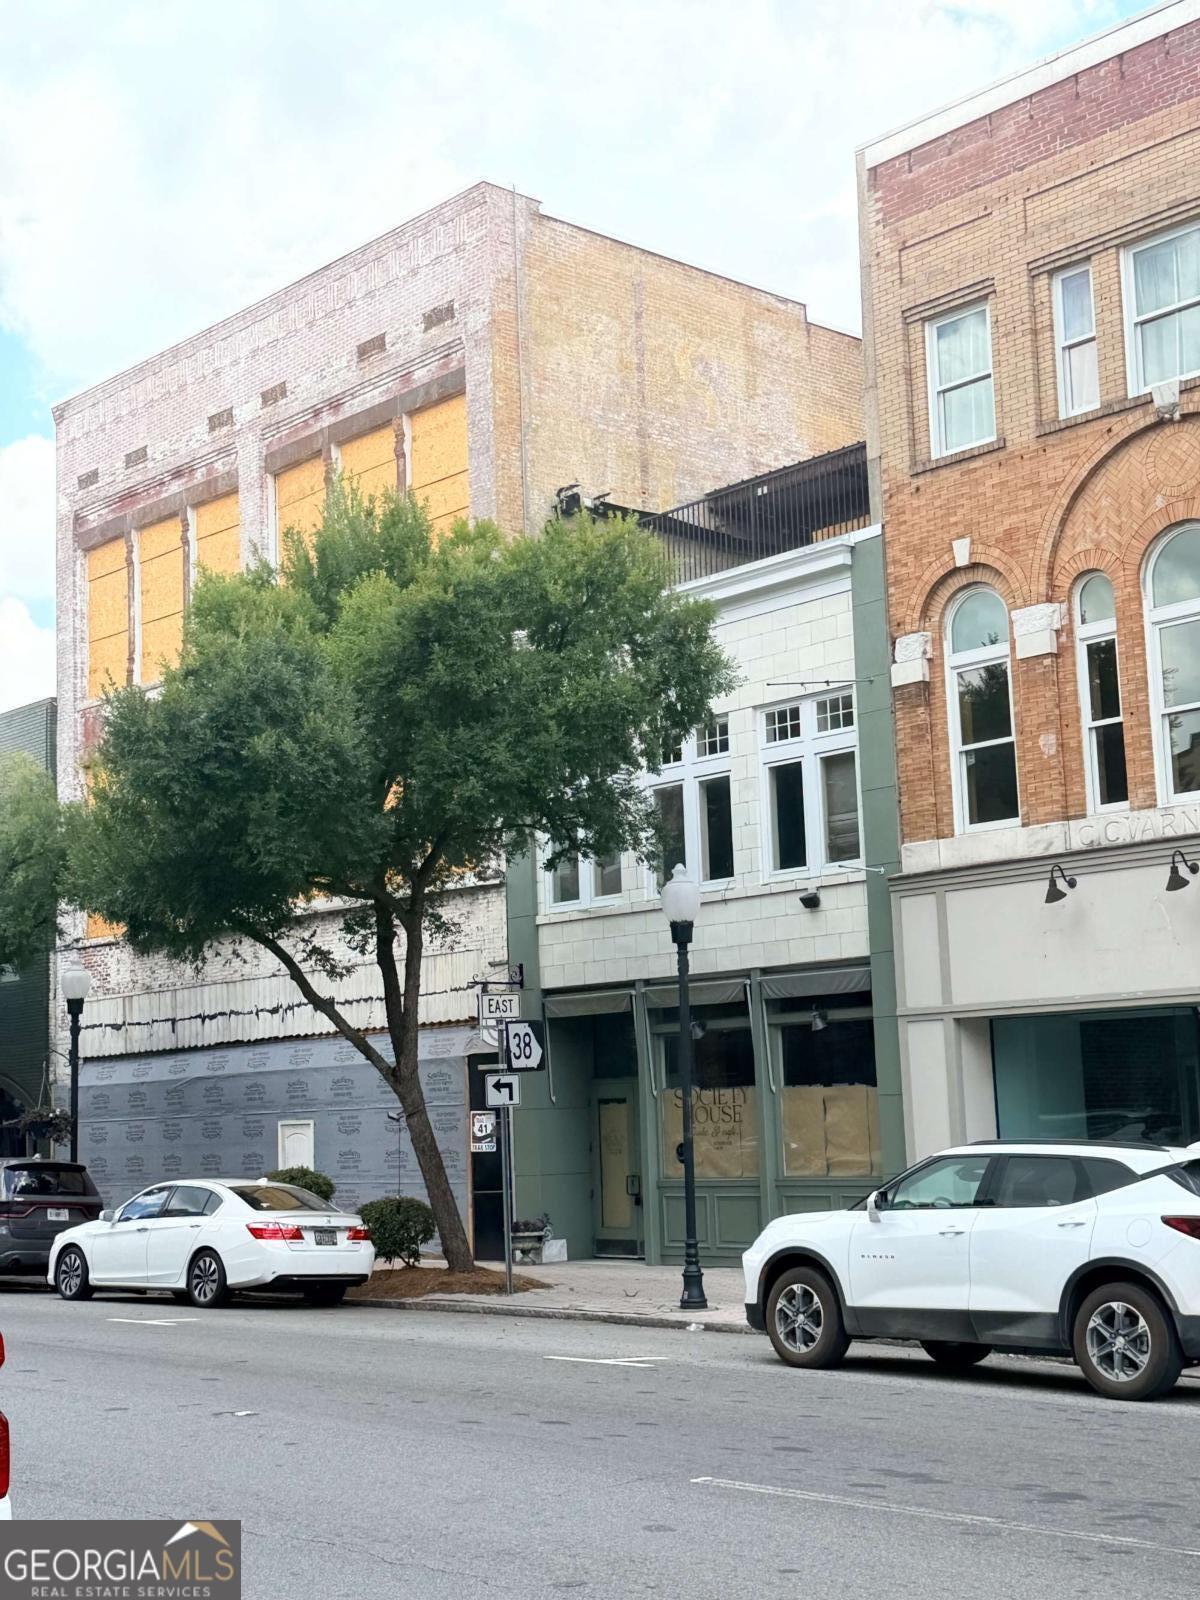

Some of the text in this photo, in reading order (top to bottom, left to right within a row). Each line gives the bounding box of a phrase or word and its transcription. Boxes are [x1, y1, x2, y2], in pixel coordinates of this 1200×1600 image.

[488, 998, 514, 1014] EAST
[512, 1032, 533, 1060] 38
[692, 1104, 743, 1124] OUSE
[477, 1123, 488, 1134] 41
